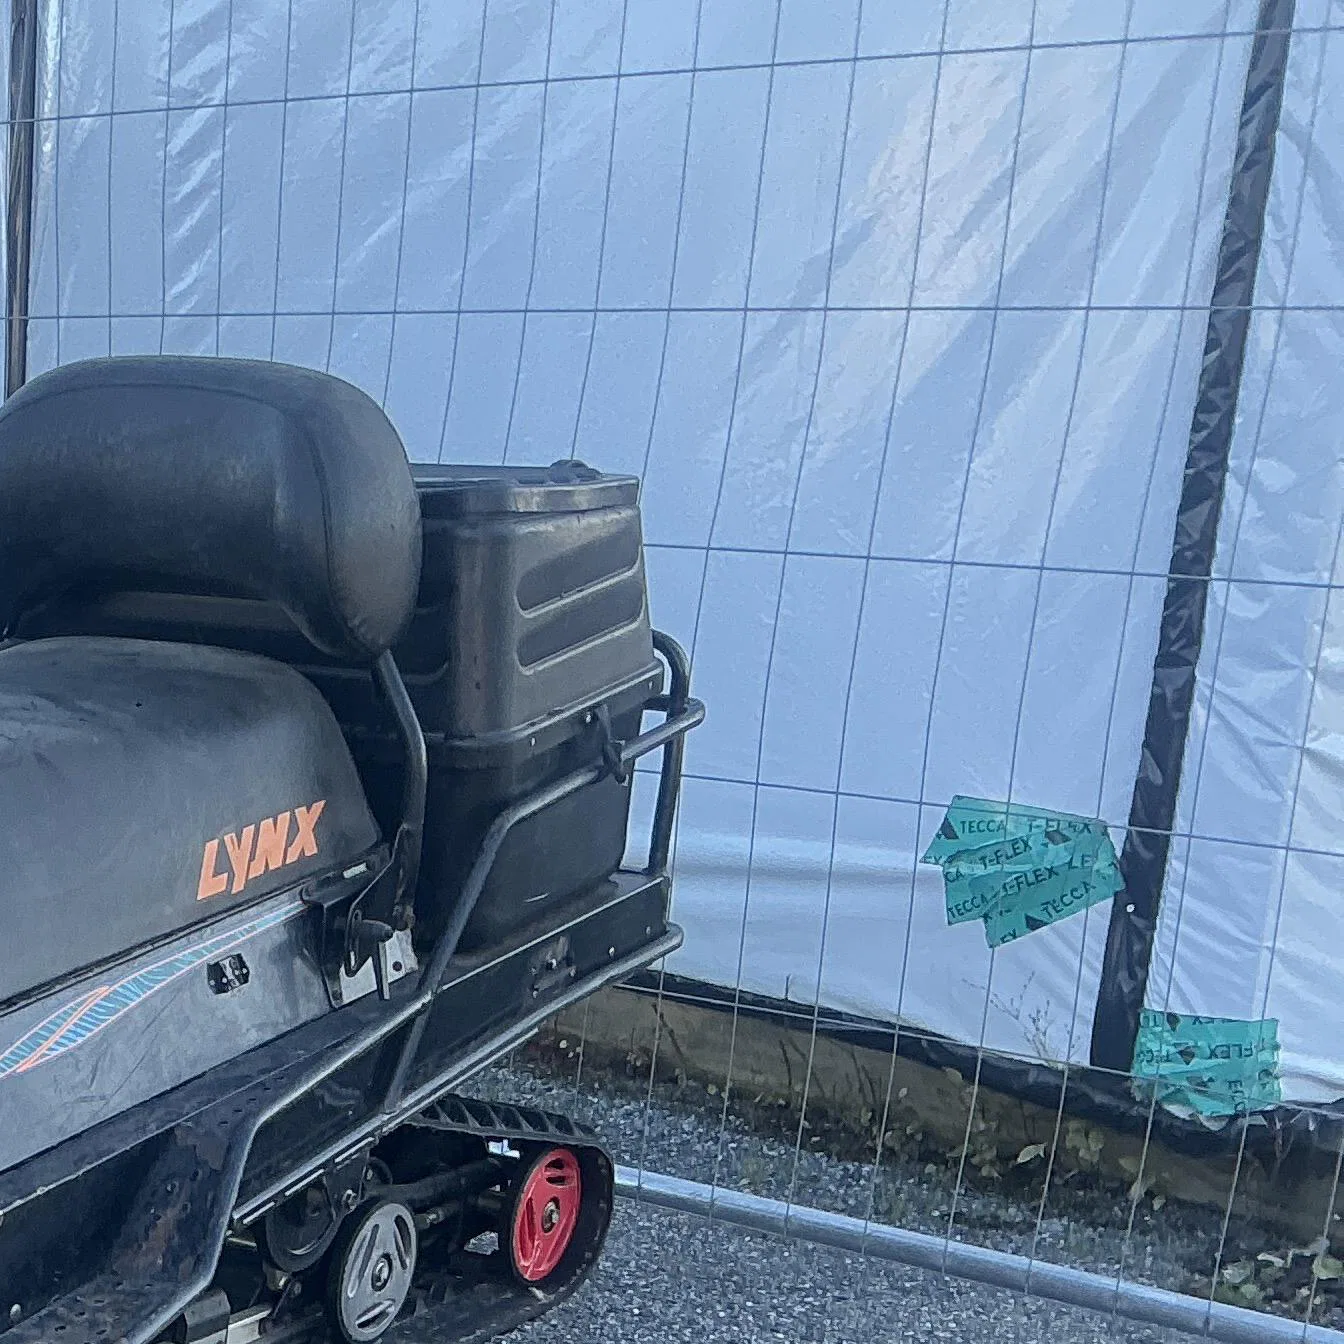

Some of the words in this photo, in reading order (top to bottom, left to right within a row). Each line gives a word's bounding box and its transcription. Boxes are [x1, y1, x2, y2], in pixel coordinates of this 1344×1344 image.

[960, 820, 1006, 834] TECCA
[196, 800, 326, 900] LYNX
[978, 836, 1032, 870] T-FLEX
[1041, 880, 1096, 918] TECCA
